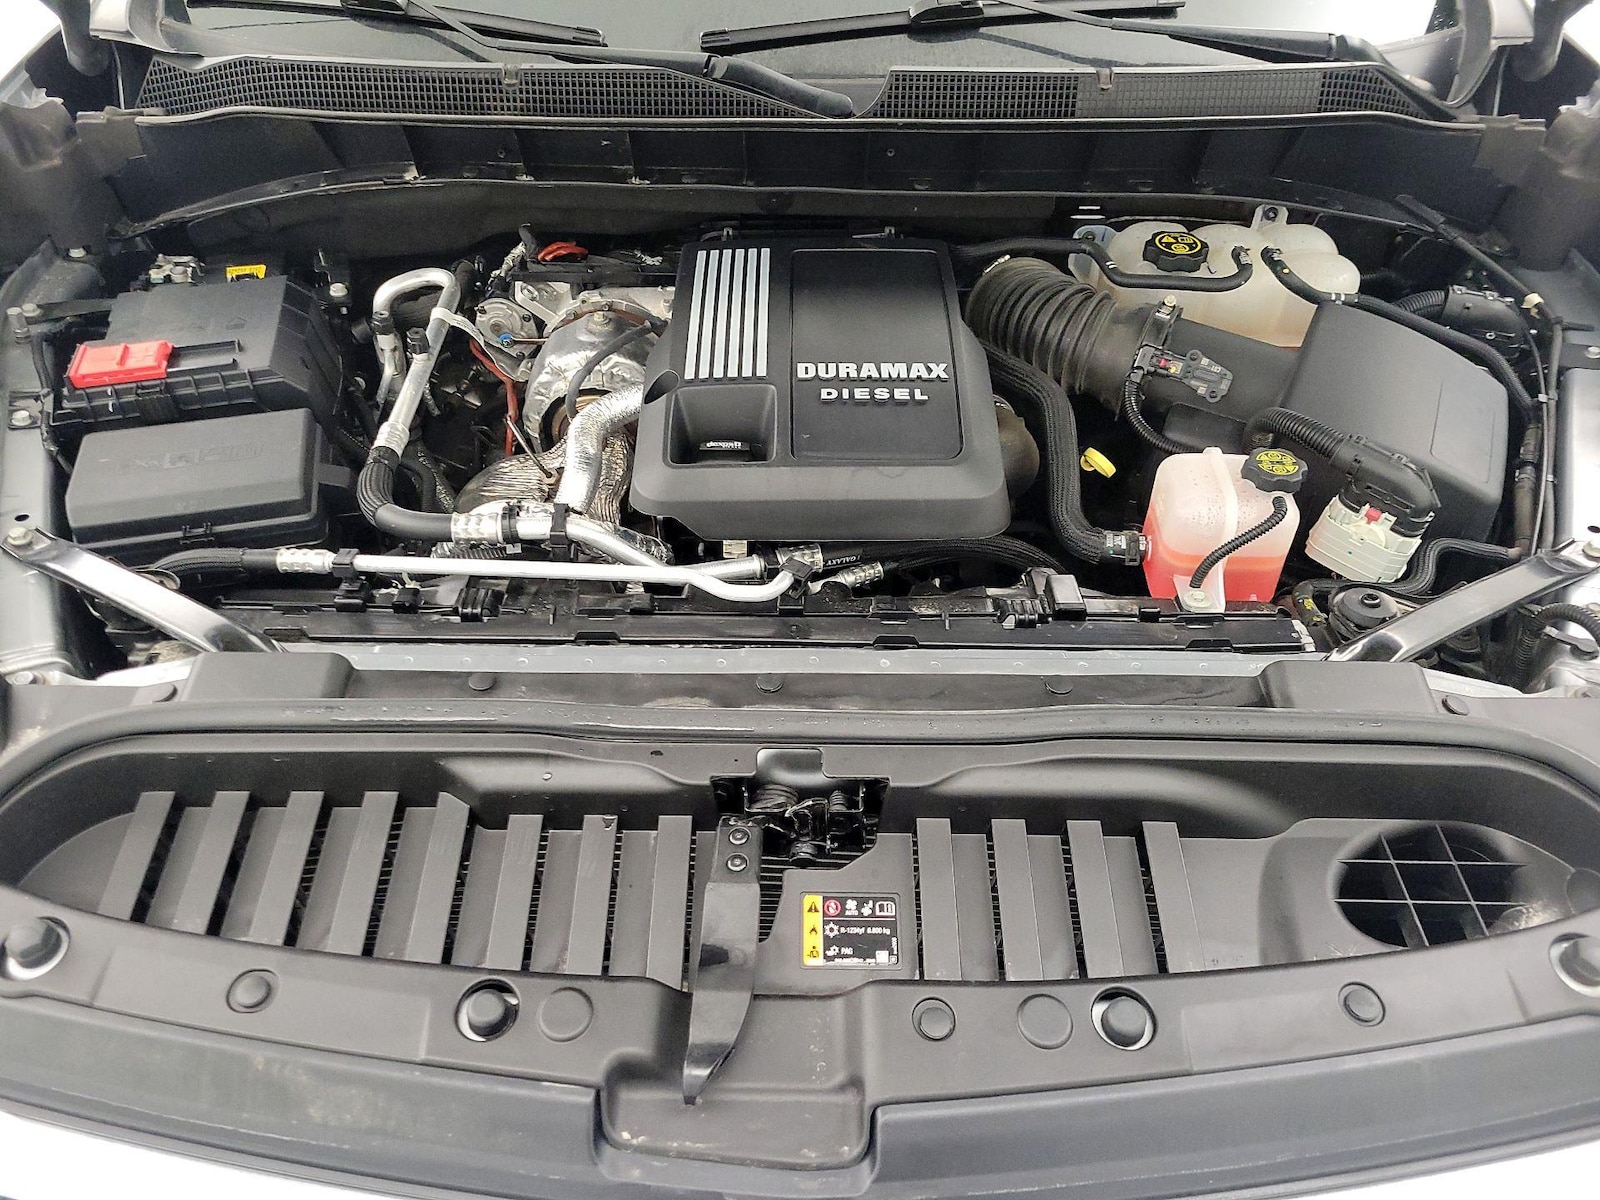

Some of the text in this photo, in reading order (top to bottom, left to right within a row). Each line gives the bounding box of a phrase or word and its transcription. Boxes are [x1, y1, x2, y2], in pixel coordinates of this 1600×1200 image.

[796, 362, 949, 380] DURAMAX
[820, 387, 929, 401] DIESEL
[826, 555, 857, 567] GALAXY
[883, 926, 891, 935] kg
[840, 947, 853, 955] PAG
